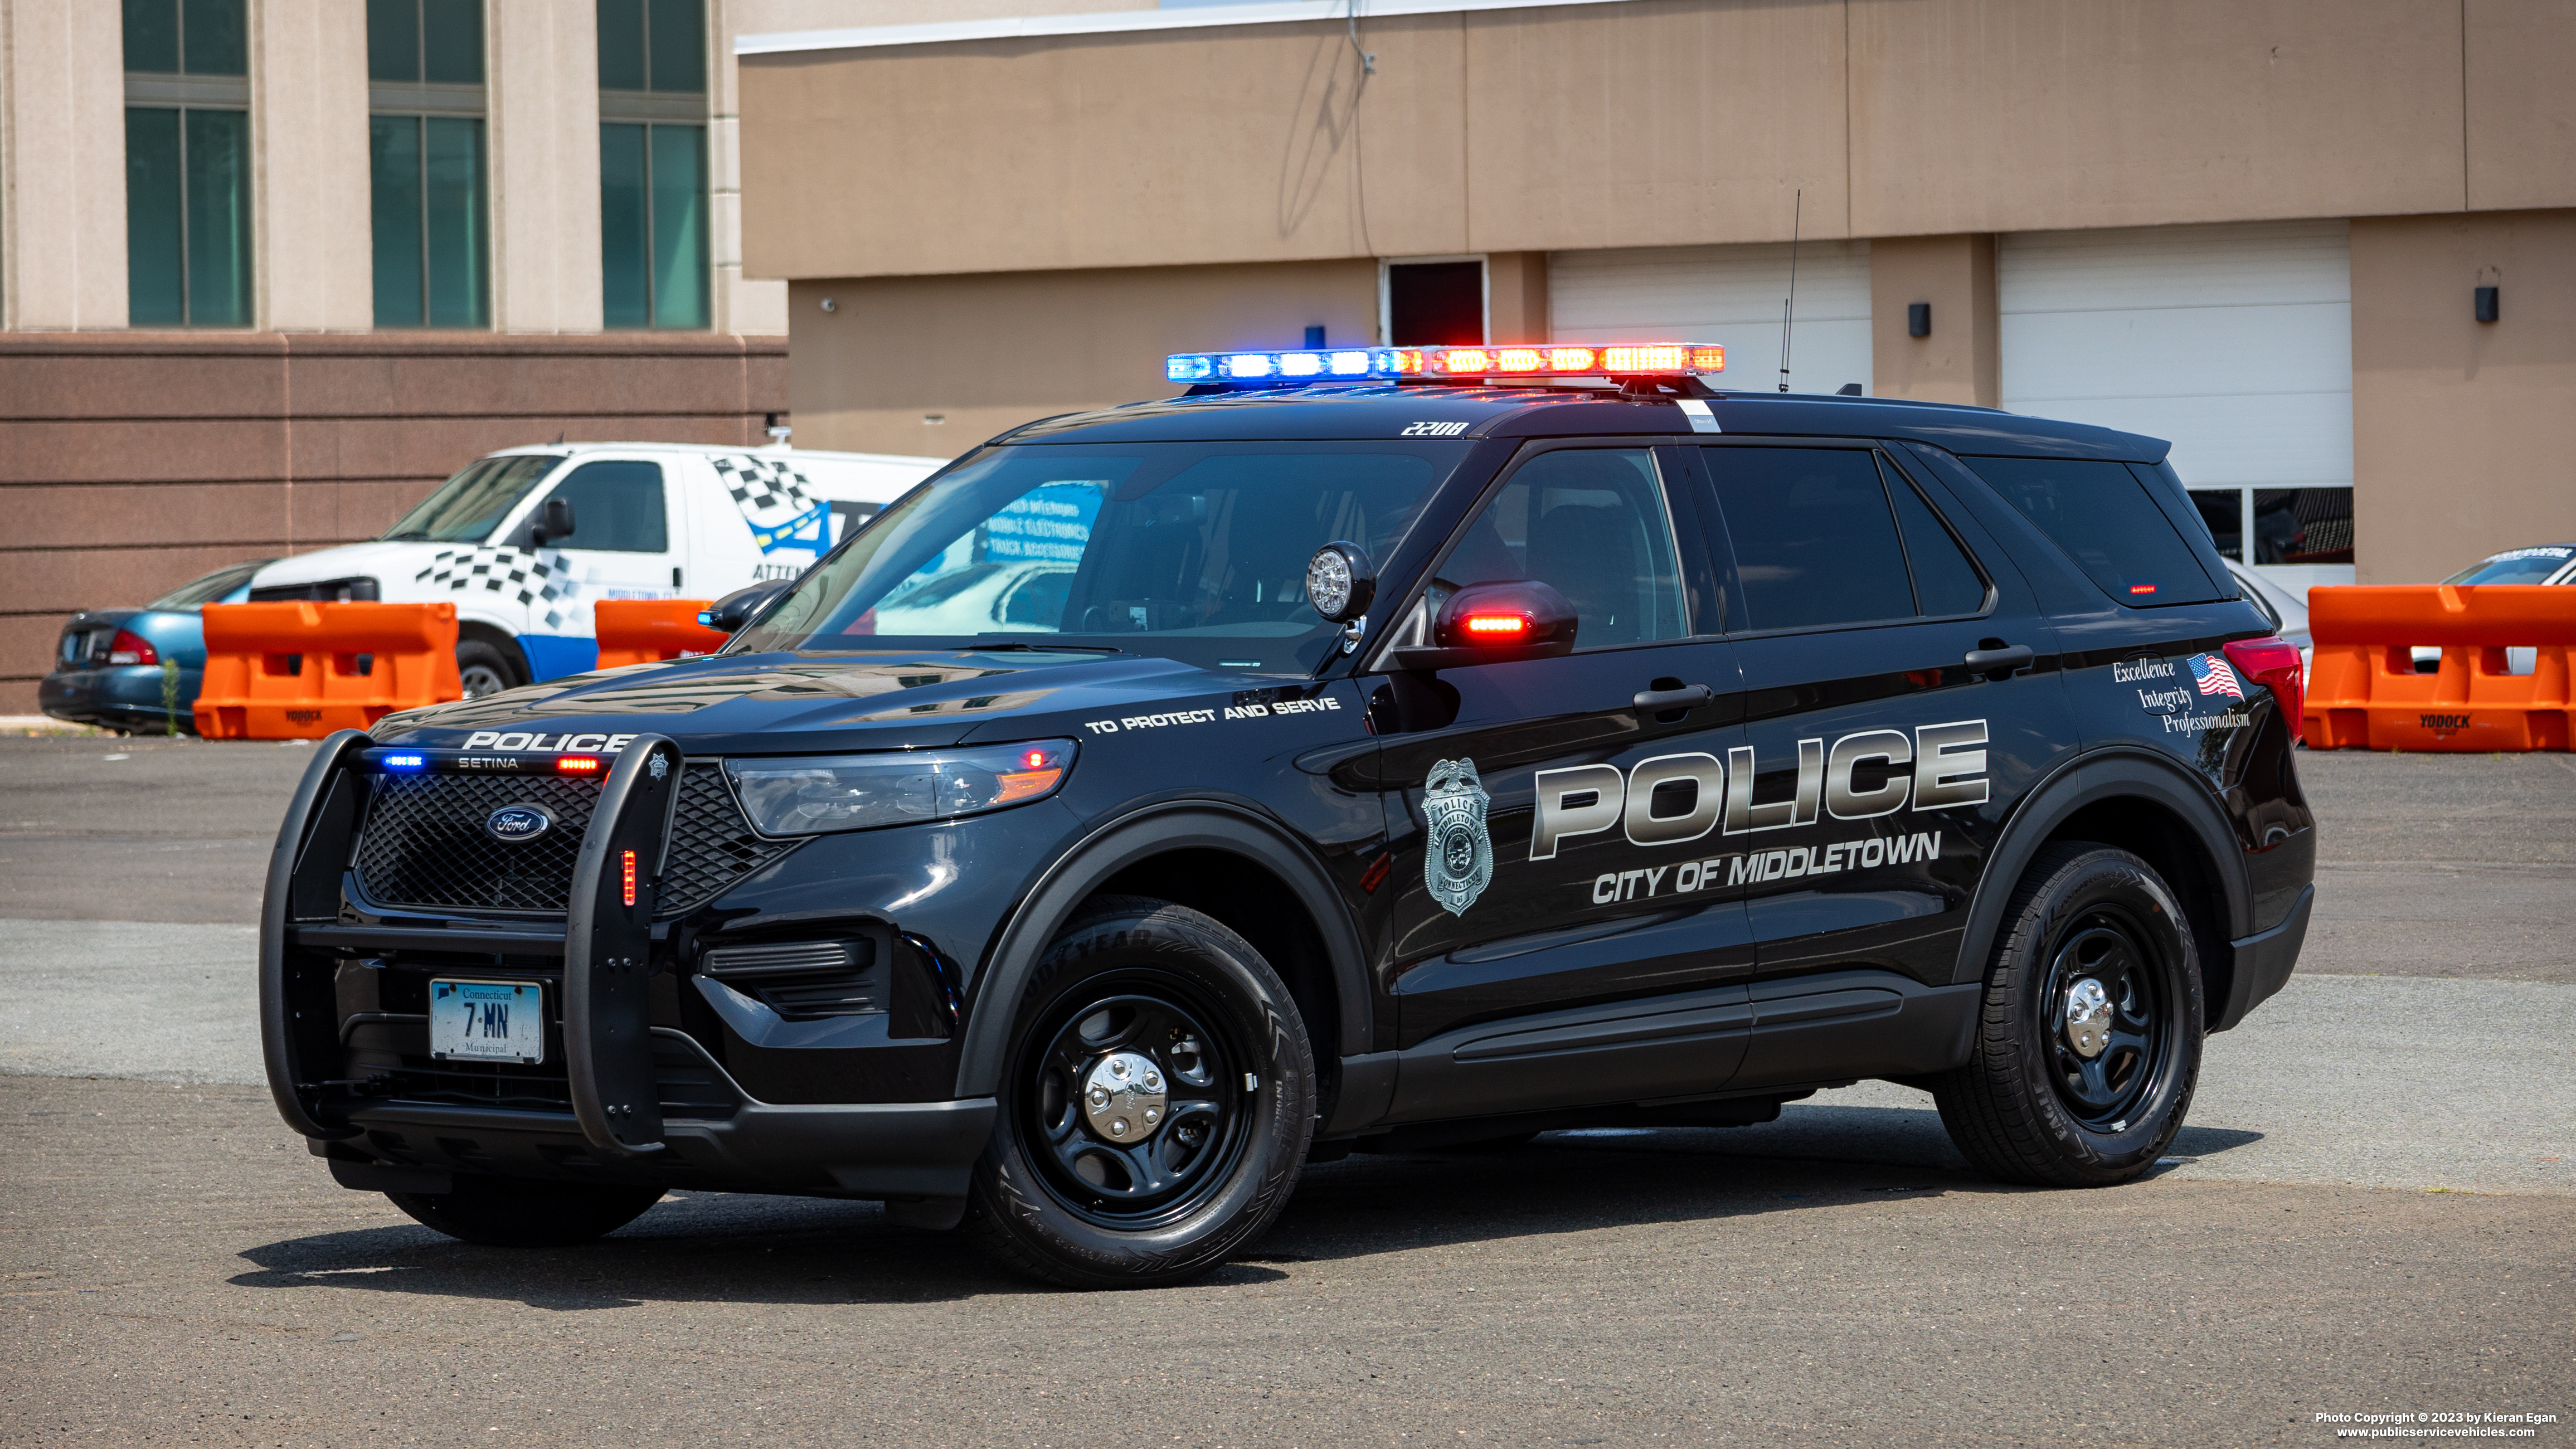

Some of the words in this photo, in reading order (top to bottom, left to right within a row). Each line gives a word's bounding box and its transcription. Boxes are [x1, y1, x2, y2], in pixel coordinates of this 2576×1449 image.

[1401, 422, 1469, 435] 2208
[2112, 658, 2175, 683] Excellence
[2137, 687, 2193, 712] Integrity
[1085, 720, 1118, 733] TO
[1121, 709, 1216, 730] PROTECT
[1224, 704, 1268, 719] AND
[1271, 697, 1341, 715] SERVE
[2162, 707, 2250, 738] Professionalism
[2421, 714, 2470, 728] YODOCK
[462, 731, 640, 752] POLICE
[459, 757, 518, 768] SETINA
[1529, 718, 1989, 862] POLICE
[1438, 799, 1474, 816] POLICE
[498, 813, 532, 831] Ford
[1436, 814, 1479, 838] MIDDLETOWN
[1592, 865, 1668, 904] CITY
[1676, 860, 1721, 892] OF
[1728, 830, 1941, 886] MIDDLETOWN
[1440, 871, 1480, 889] CONNECTICUT
[1456, 895, 1463, 903] 16
[463, 988, 512, 1000] Connecticut
[465, 1042, 507, 1054] Municipal
[2033, 1082, 2068, 1141] EAGLE
